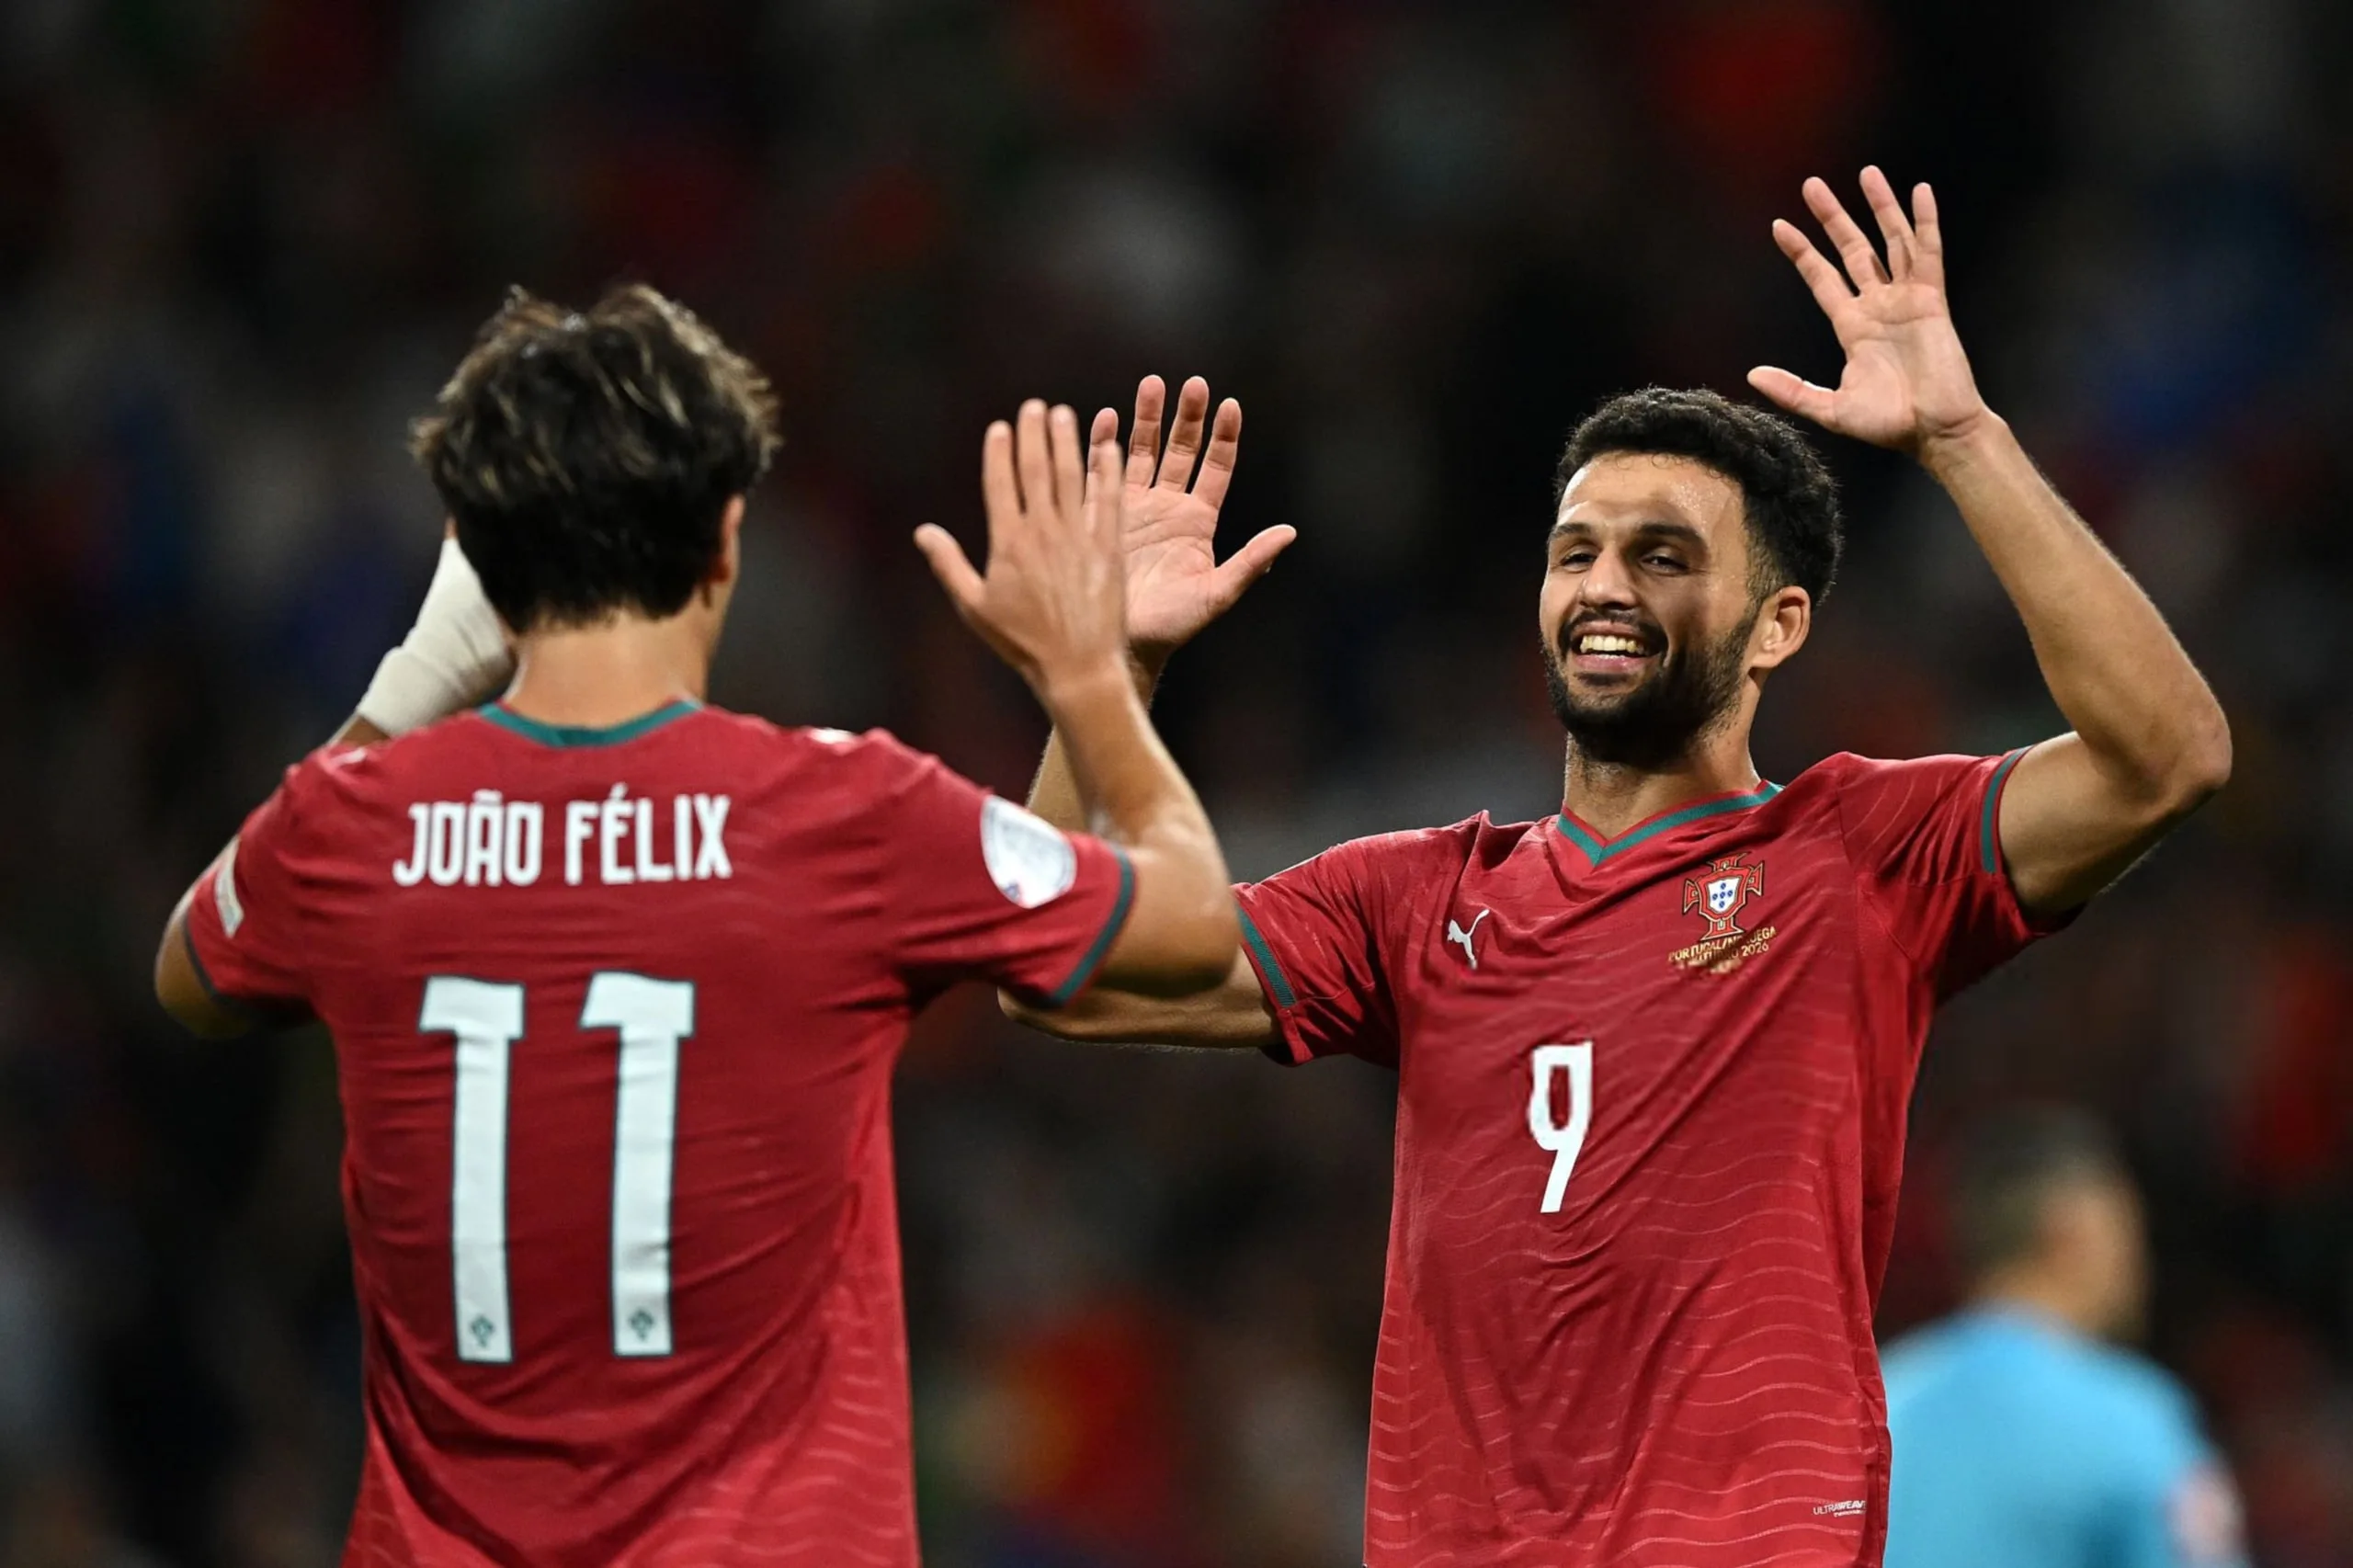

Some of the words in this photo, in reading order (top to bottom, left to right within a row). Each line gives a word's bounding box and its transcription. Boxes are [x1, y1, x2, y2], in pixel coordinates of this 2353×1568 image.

[392, 789, 544, 887] JOÃO
[564, 781, 733, 886] FÉLIX
[1741, 941, 1769, 957] 2026
[418, 971, 696, 1364] 11
[1528, 1038, 1594, 1214] 9
